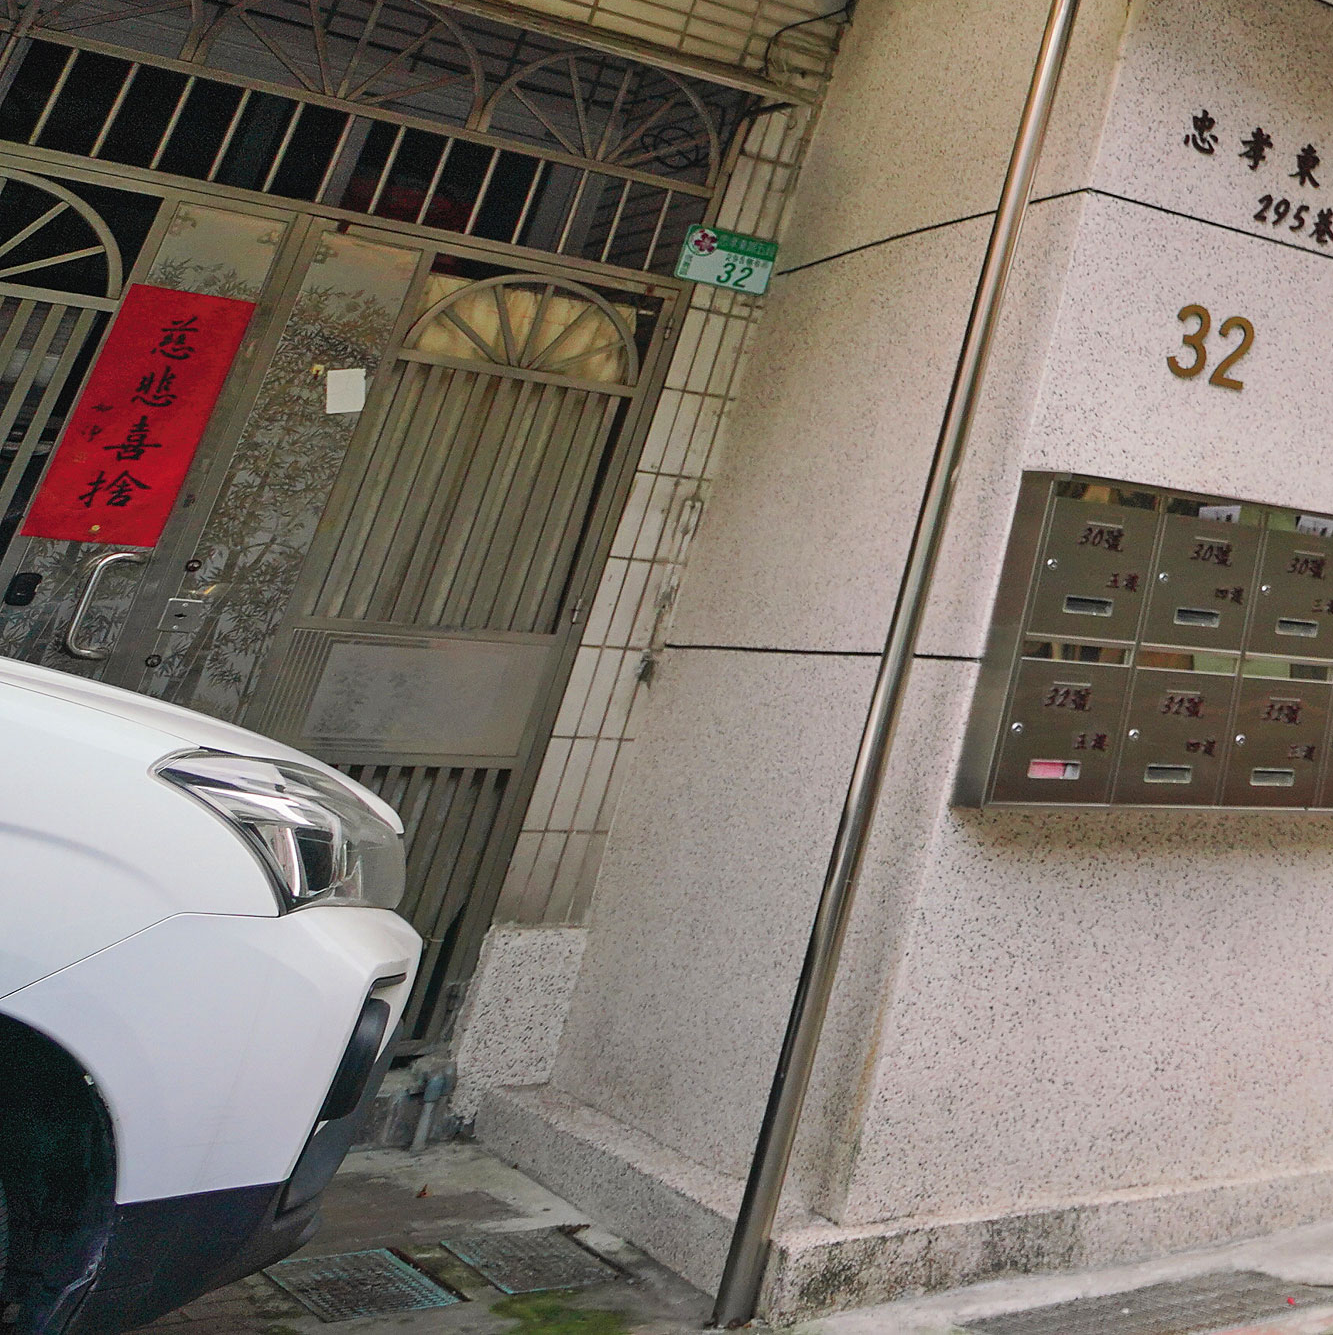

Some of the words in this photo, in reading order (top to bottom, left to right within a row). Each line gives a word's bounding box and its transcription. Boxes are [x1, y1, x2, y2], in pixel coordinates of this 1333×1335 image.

[716, 263, 753, 288] 32
[1166, 304, 1255, 392] 32
[78, 317, 198, 508] 慈悲喜捨
